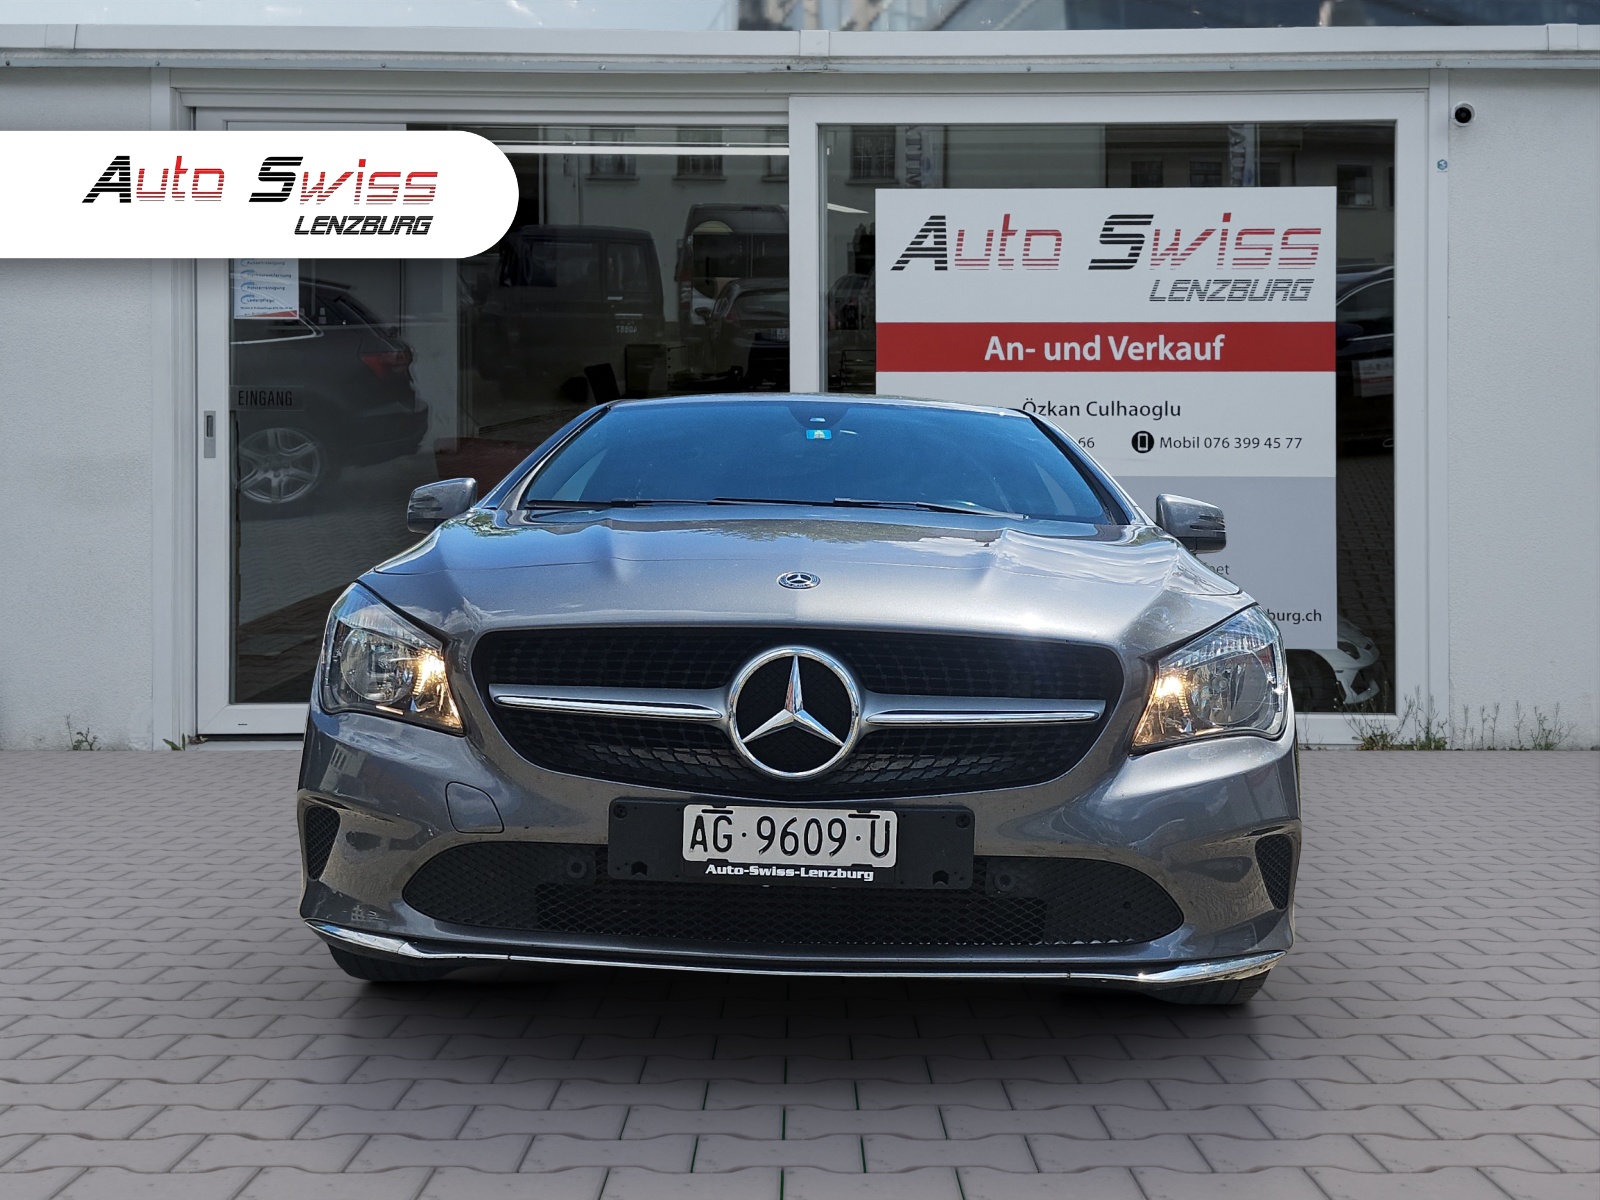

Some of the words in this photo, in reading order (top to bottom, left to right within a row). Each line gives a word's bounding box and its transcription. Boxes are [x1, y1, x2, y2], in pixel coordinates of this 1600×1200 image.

[891, 213, 1063, 271] Auto
[1088, 212, 1322, 271] Swiss
[1149, 278, 1315, 302] LENZBURG
[984, 334, 1037, 361] An-
[1044, 334, 1102, 361] und
[1107, 333, 1226, 361] Verkauf
[238, 390, 293, 406] EINGANG
[1022, 397, 1080, 417] Özkan
[1086, 400, 1182, 421] Culhaoglu
[1159, 436, 1201, 449] Mobil
[1203, 437, 1230, 449] 076
[1234, 437, 1260, 449] 399
[1263, 437, 1281, 449] 45
[1285, 437, 1303, 449] 77
[704, 863, 875, 882] Auto-Swiss-Lenzburg
